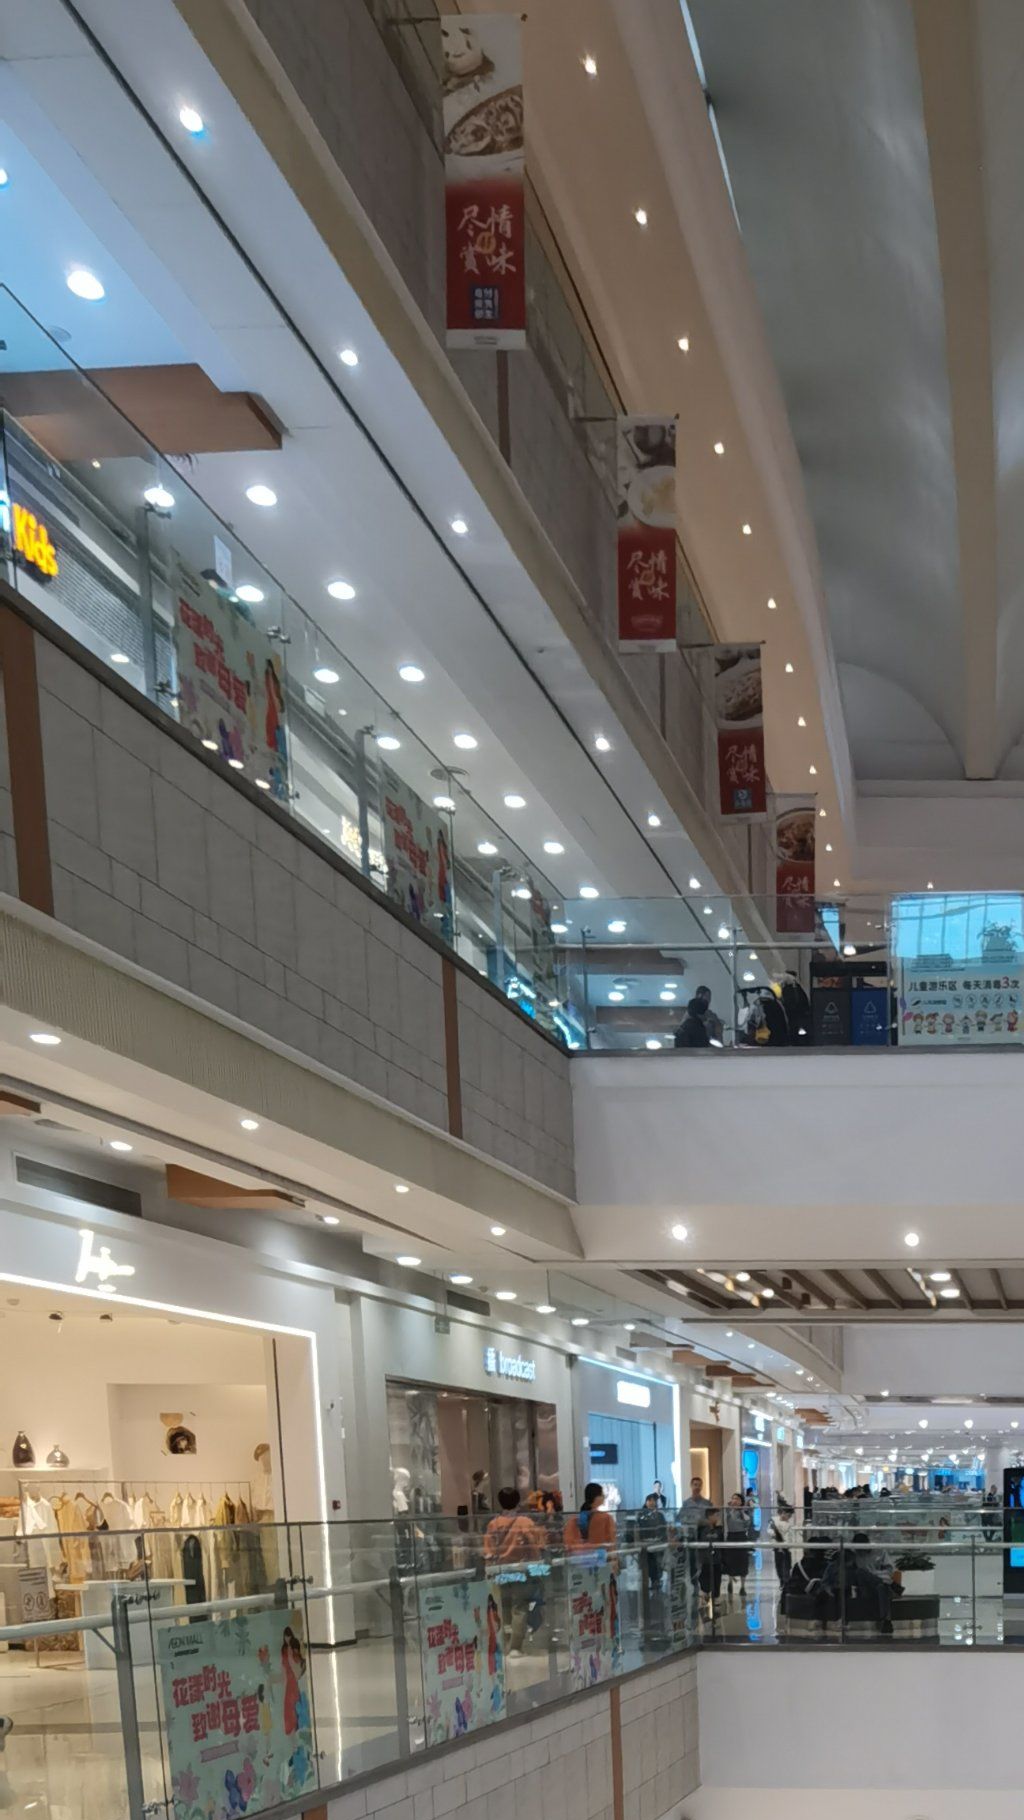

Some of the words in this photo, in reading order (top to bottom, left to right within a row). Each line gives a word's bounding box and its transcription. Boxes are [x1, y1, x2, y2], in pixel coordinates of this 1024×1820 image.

[12, 503, 58, 576] Kids
[908, 980, 957, 992] 儿童游乐区
[499, 1350, 536, 1380] broadcast
